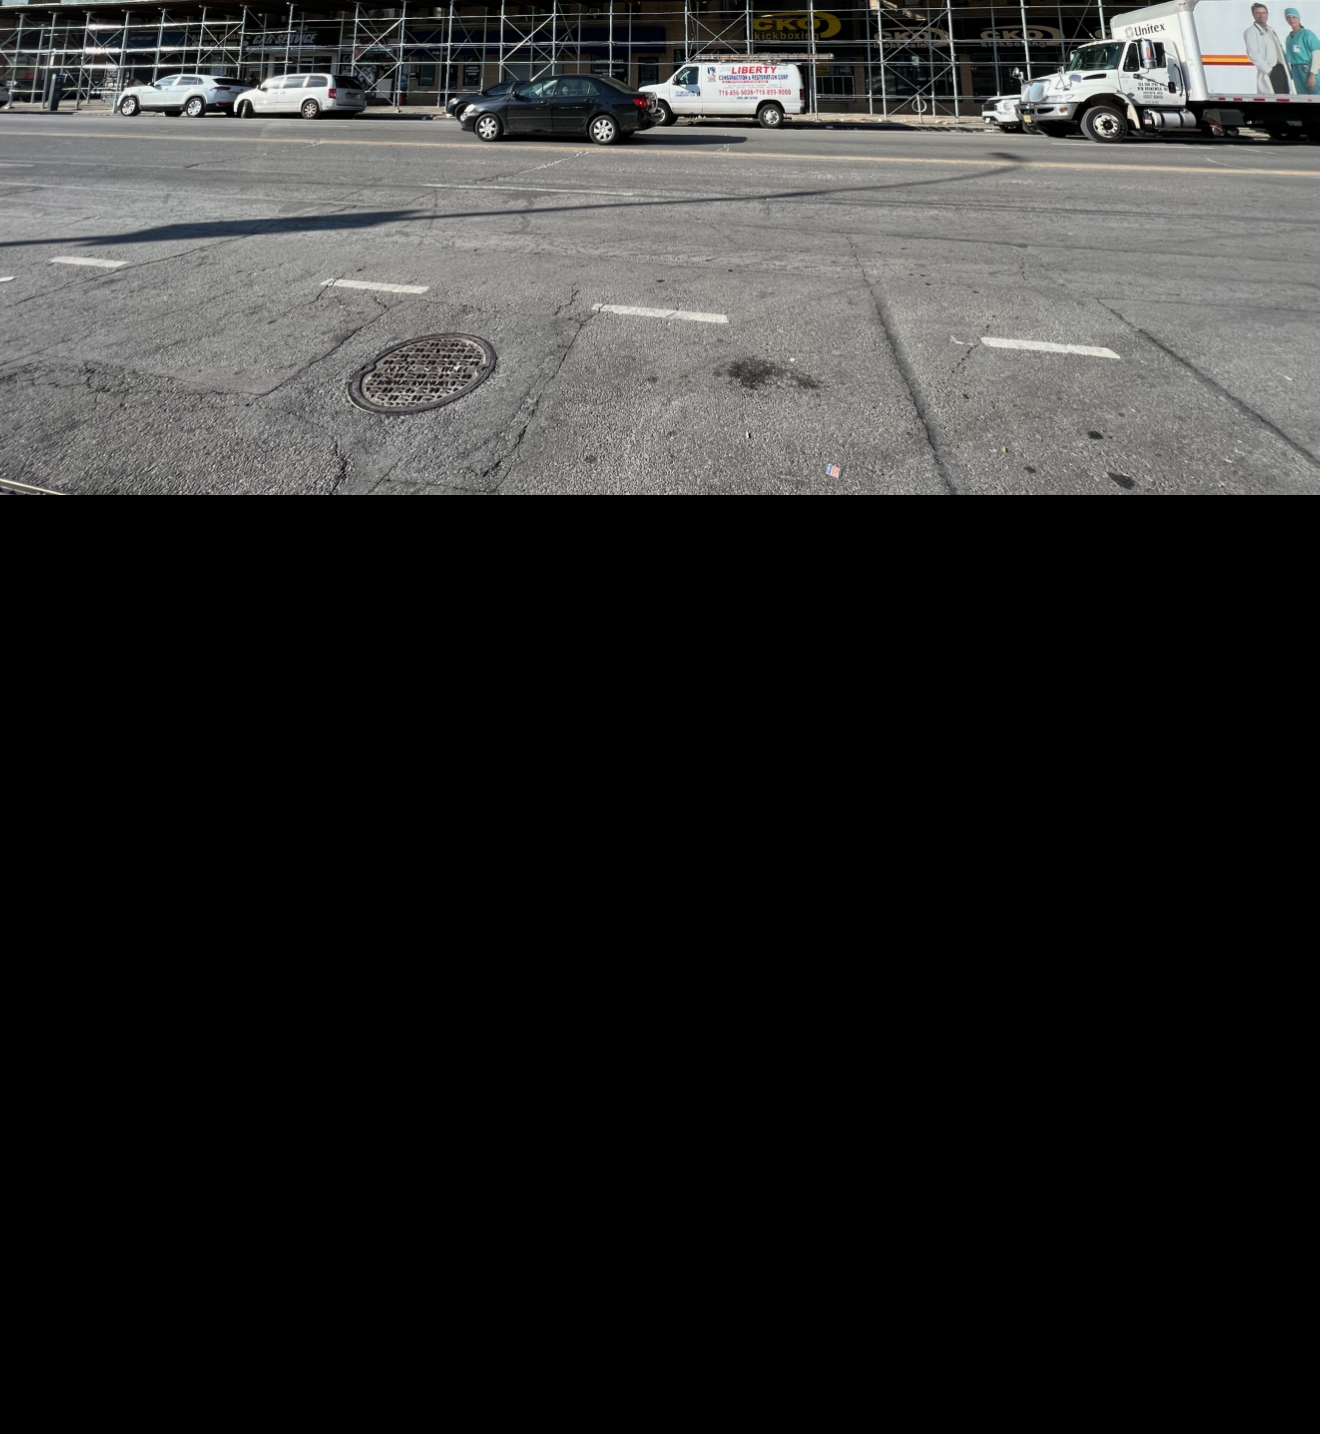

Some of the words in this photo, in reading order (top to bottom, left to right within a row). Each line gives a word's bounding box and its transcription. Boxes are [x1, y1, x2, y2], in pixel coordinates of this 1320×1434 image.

[753, 18, 822, 31] CKO
[980, 30, 1044, 40] CKO
[1134, 24, 1166, 37] Unitex
[731, 66, 777, 74] LIBERTY
